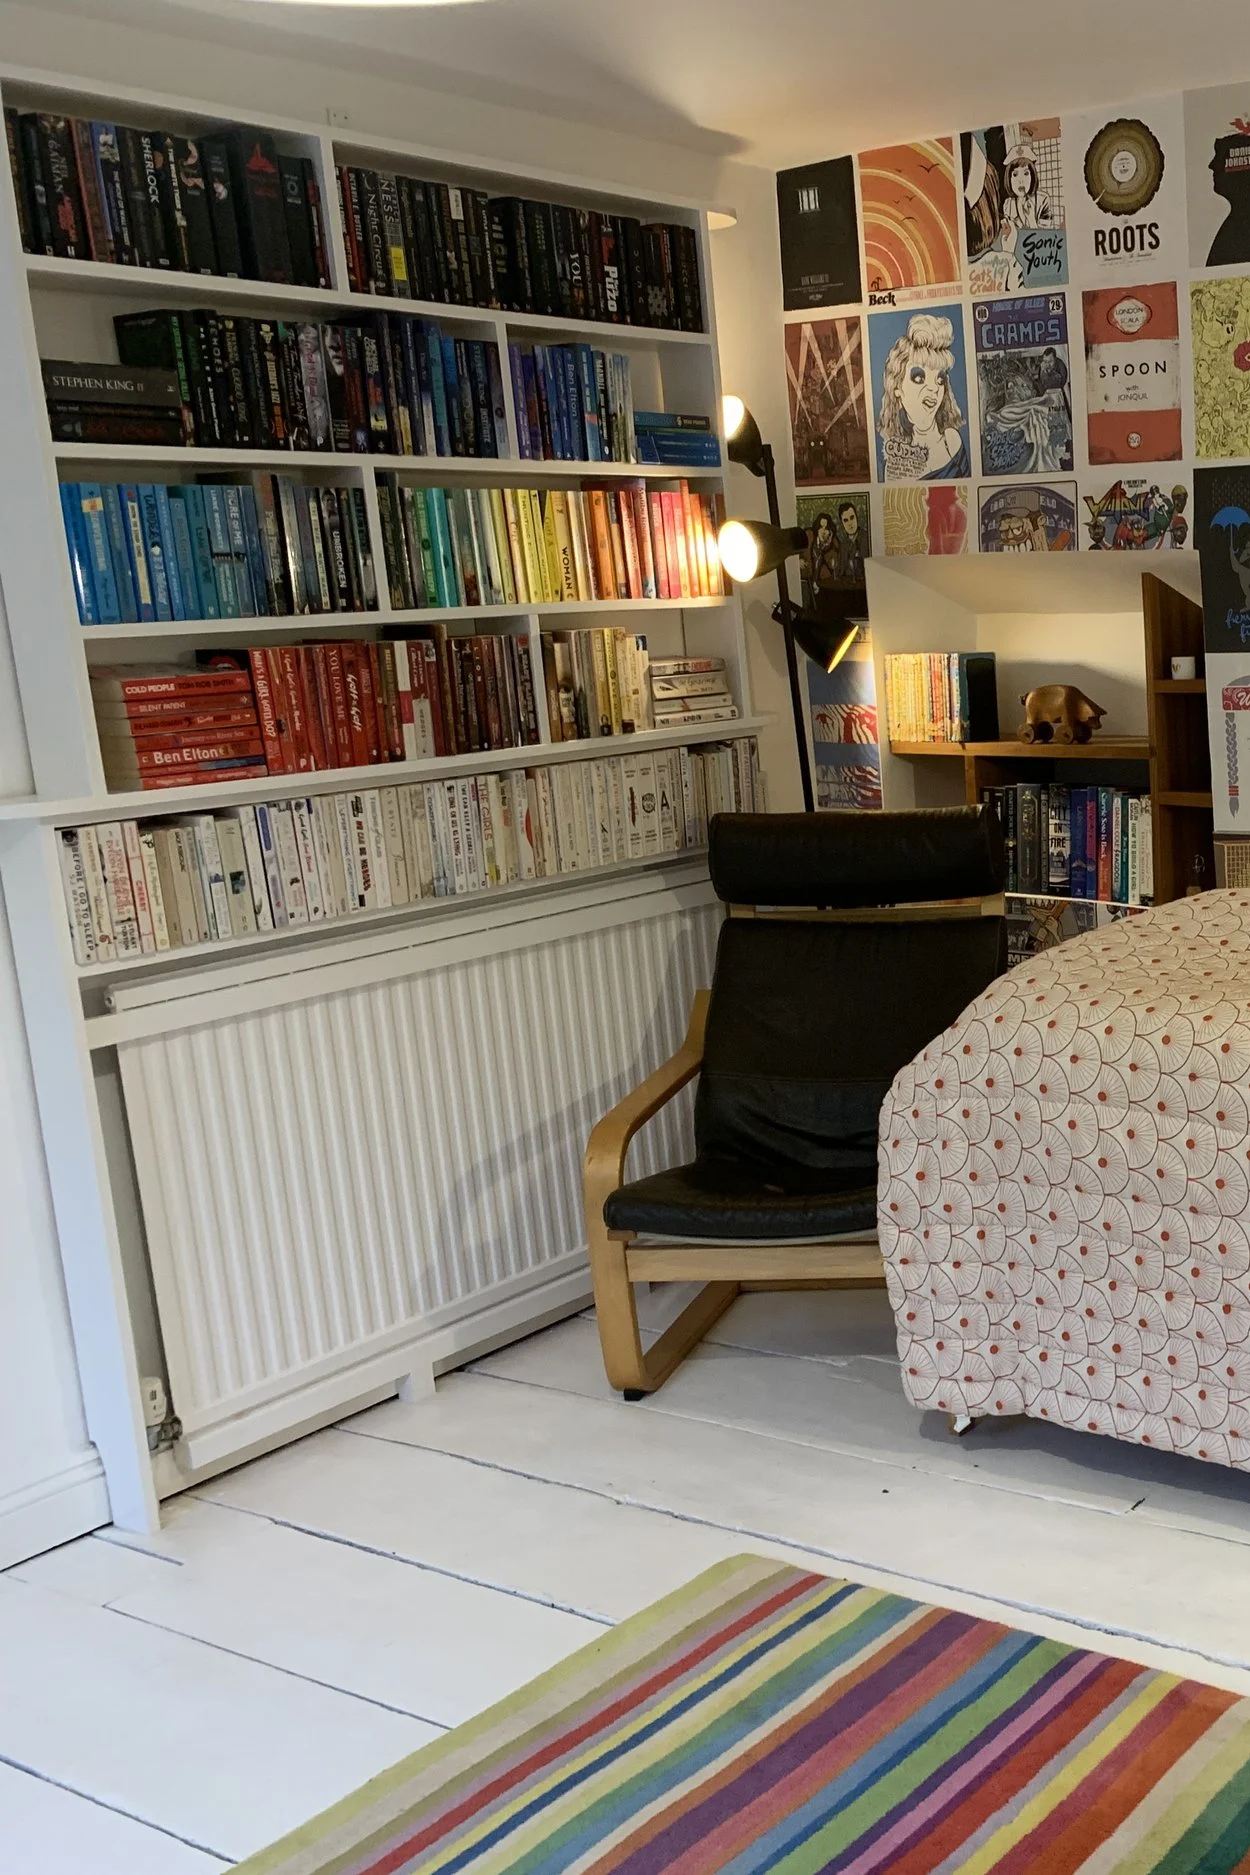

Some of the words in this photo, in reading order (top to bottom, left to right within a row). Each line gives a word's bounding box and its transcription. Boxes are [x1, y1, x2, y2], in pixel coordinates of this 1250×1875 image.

[141, 136, 160, 204] SHERLOCK
[379, 179, 396, 222] NESS
[1022, 232, 1064, 253] Sonic
[1094, 222, 1161, 257] ROOTS
[372, 233, 387, 275] Circus
[1023, 249, 1063, 275] Youth
[603, 265, 619, 312] Puzo
[868, 292, 896, 306] Beck
[981, 319, 1061, 348] CRAMPS
[567, 363, 576, 385] Ben
[1099, 360, 1167, 379] SPOON
[52, 375, 103, 389] STEPHEN
[106, 380, 134, 391] KING
[568, 387, 579, 417] Elton
[226, 489, 240, 519] MORE
[331, 530, 348, 588] UNBROKEN
[561, 546, 573, 590] WOMAN
[328, 649, 340, 673] YOU
[125, 685, 147, 695] COLD
[148, 682, 176, 693] PEOPLE
[256, 679, 269, 699] GIRL
[331, 676, 343, 702] LOVE
[336, 704, 346, 720] ME
[153, 751, 180, 765] Ben
[183, 748, 218, 761] Elton
[477, 782, 489, 801] THE
[480, 805, 494, 841] GIRLS
[1050, 837, 1067, 849] FIRE
[71, 846, 83, 883] BEFORE
[79, 892, 87, 905] GO
[135, 880, 147, 913] CHERRY
[81, 907, 89, 921] TO
[83, 922, 94, 952] SLEEP
